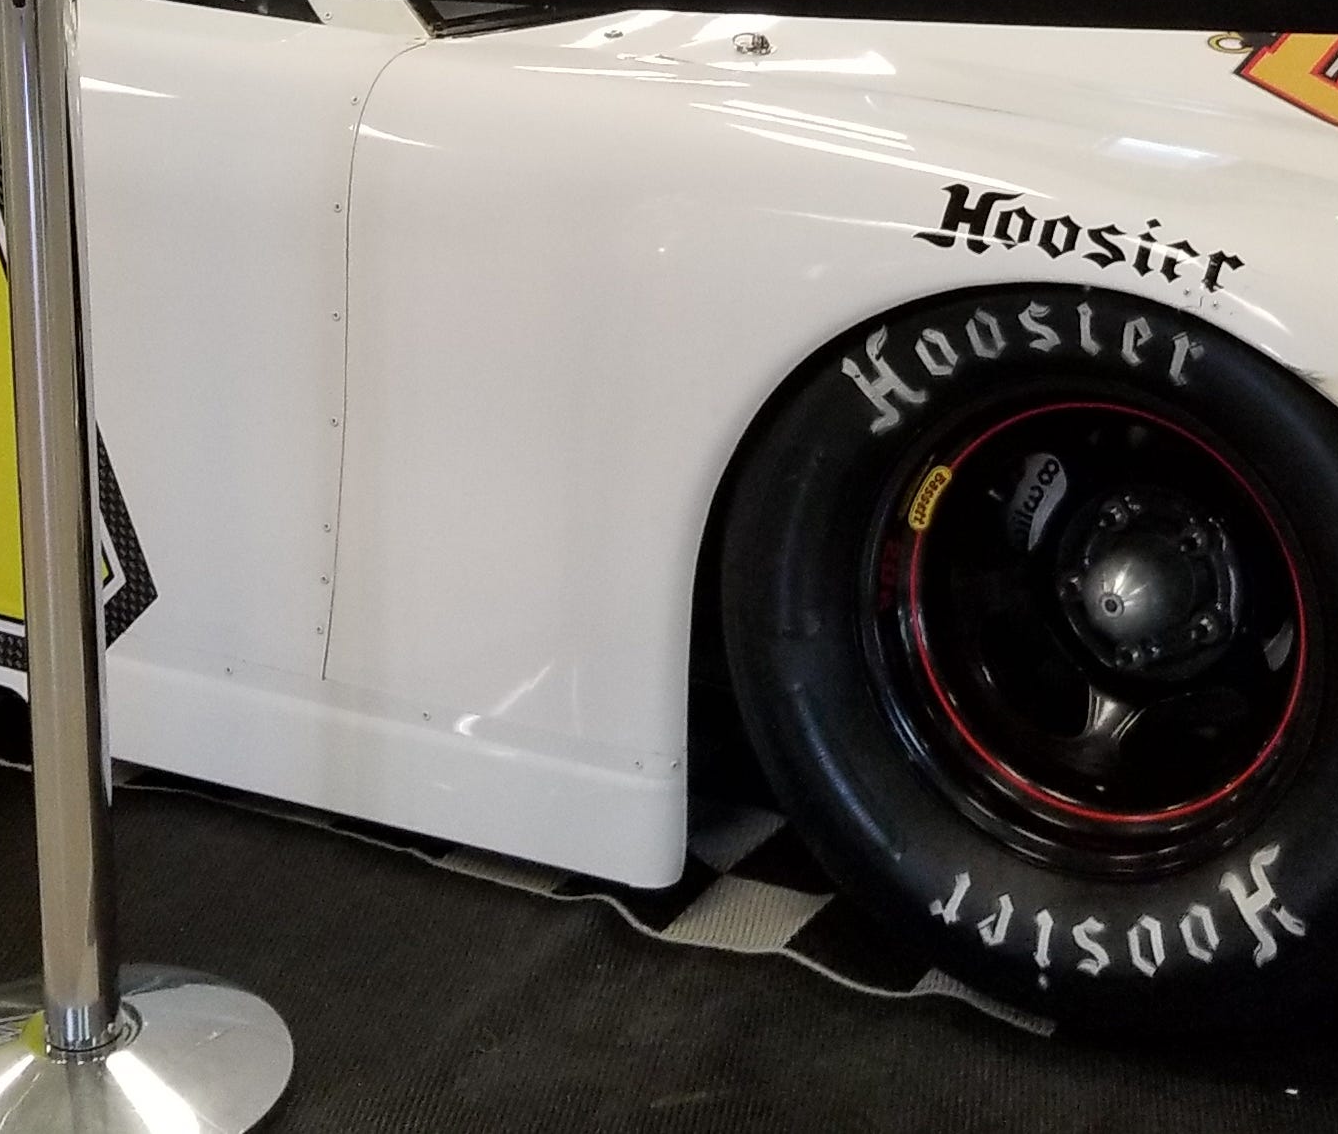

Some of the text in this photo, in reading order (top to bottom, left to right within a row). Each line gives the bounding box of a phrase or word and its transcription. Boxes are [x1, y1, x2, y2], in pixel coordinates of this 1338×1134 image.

[914, 182, 1246, 294] Hoosier
[842, 300, 1209, 435] Hoosier
[929, 843, 1307, 989] Hoosier
